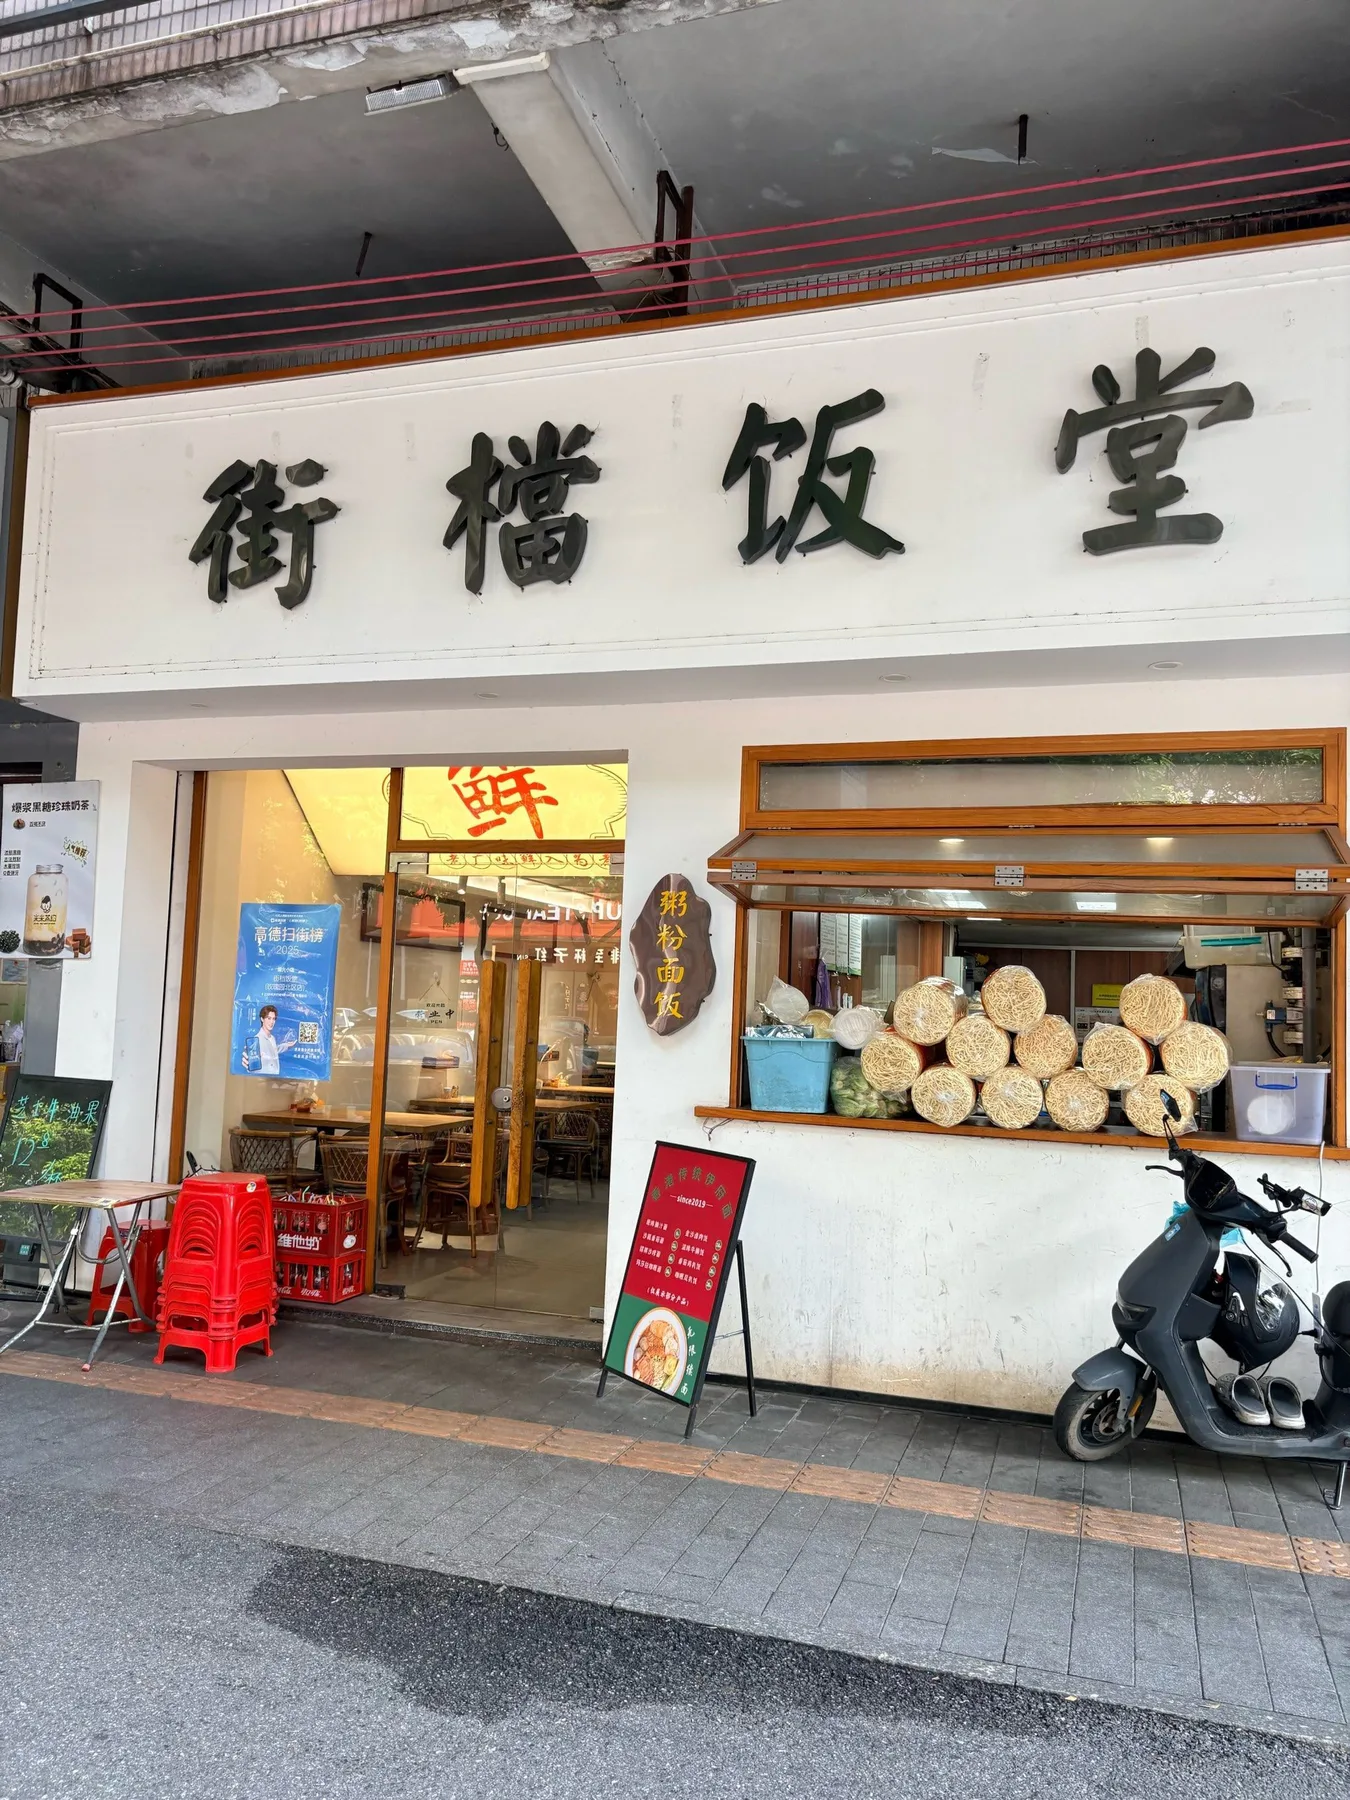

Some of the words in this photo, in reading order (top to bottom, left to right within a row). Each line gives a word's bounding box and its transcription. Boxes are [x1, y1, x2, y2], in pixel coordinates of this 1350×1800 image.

[11, 800, 89, 813] 爆浆黑糖珍珠奶茶
[448, 766, 559, 840] 鲜
[254, 926, 324, 943] 高德扫街榜
[276, 945, 299, 955] 2025
[654, 890, 688, 1019] 粥粉面饭
